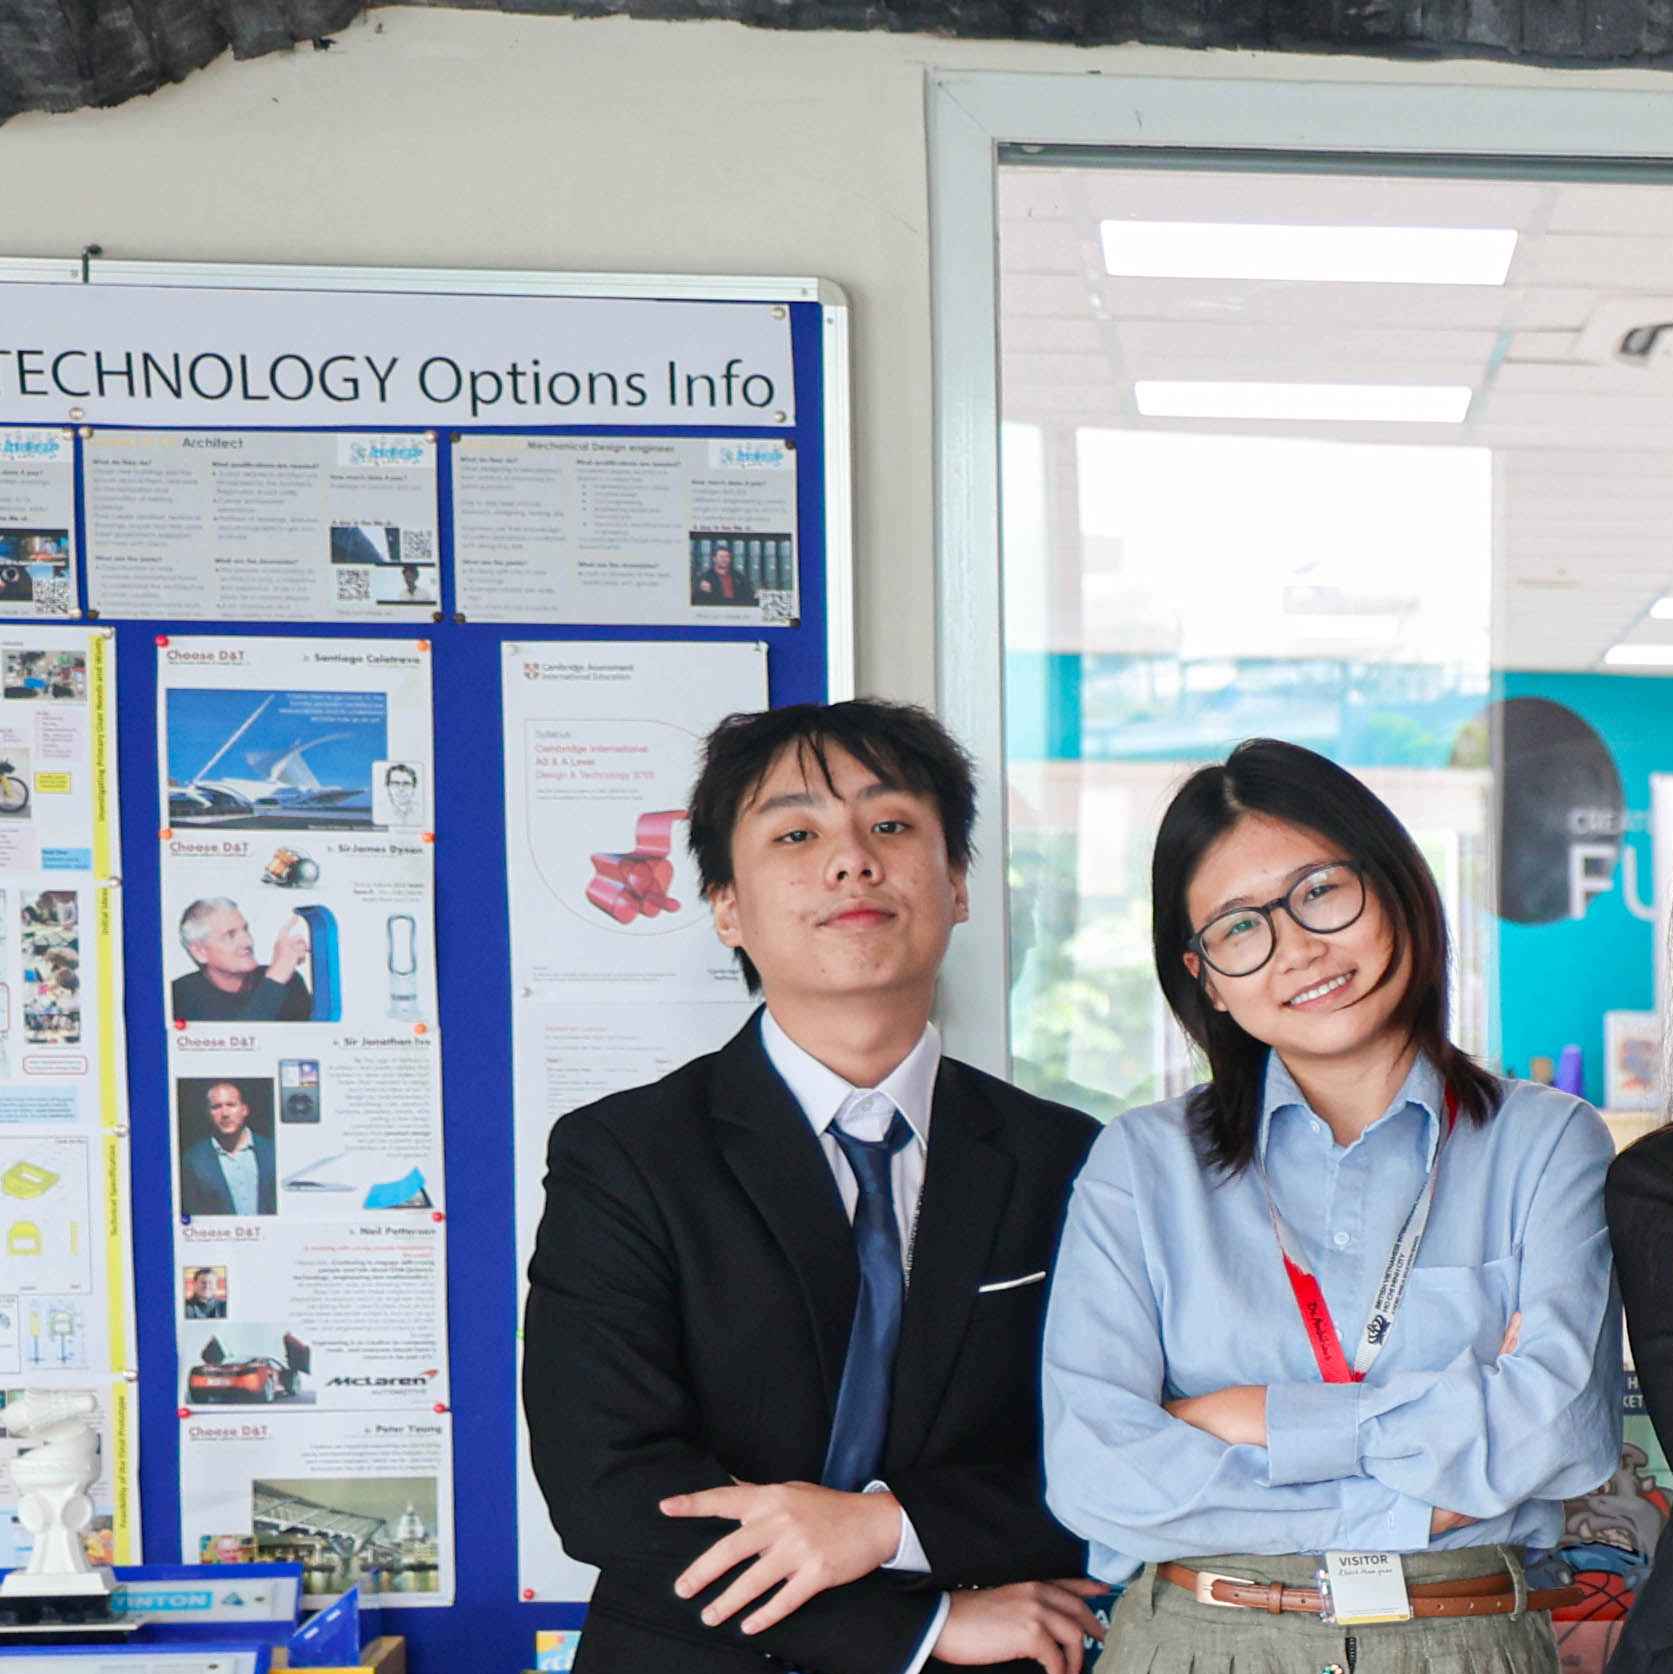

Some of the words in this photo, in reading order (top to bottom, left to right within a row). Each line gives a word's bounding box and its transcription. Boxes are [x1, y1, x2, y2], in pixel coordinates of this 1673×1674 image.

[418, 356, 647, 417] Options
[667, 356, 776, 410] Info
[182, 437, 244, 450] Architect
[167, 650, 215, 661] Choose
[219, 650, 244, 661] D&T
[169, 842, 219, 853] Choose
[223, 842, 249, 852] D&T
[176, 1037, 226, 1048] Choose
[230, 1037, 255, 1047] D&T
[182, 1227, 231, 1238] Choose
[235, 1227, 261, 1238] D&T
[189, 1426, 238, 1437] Choose
[241, 1425, 268, 1436] D&T
[1339, 1554, 1388, 1566] VISITOR
